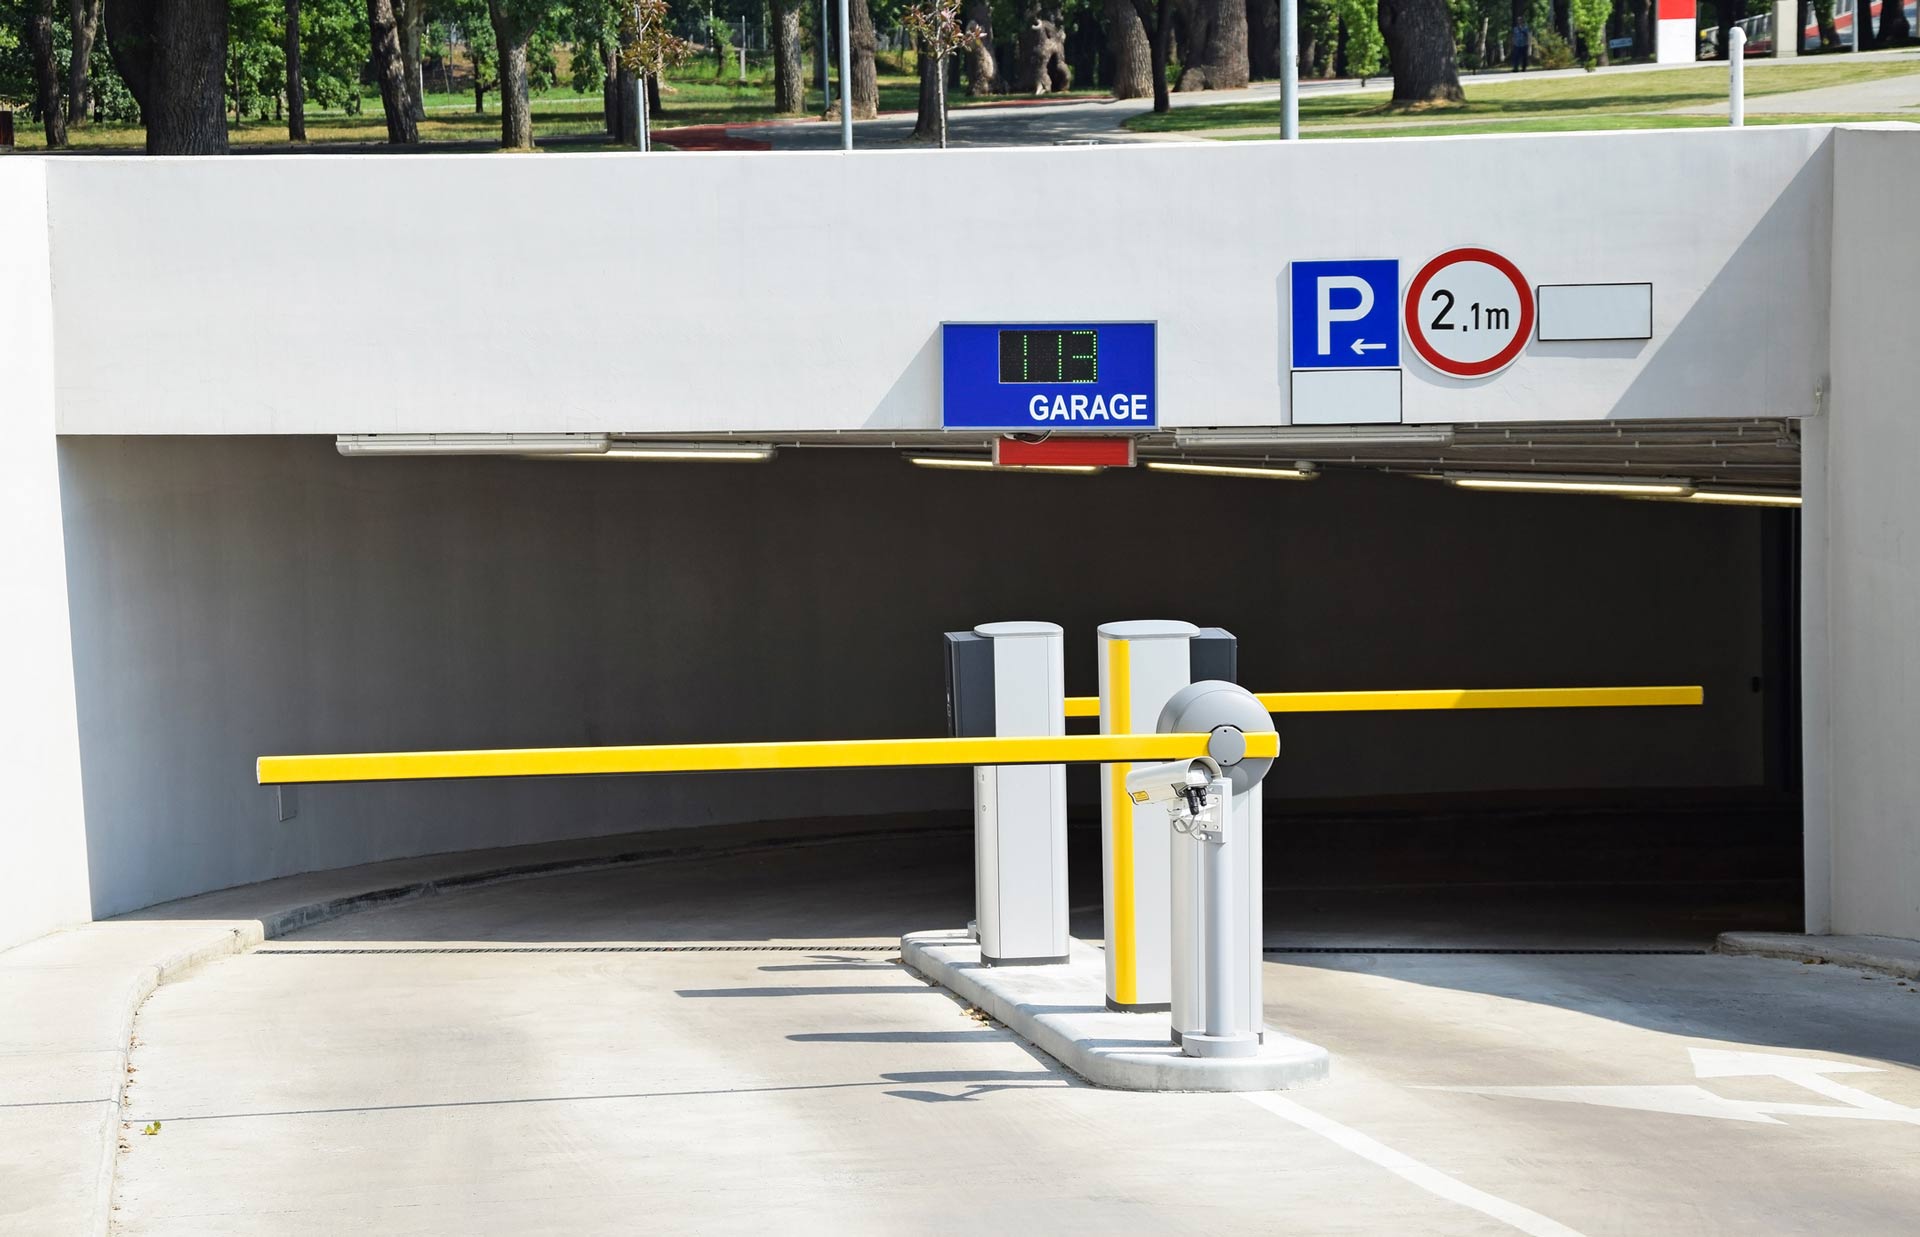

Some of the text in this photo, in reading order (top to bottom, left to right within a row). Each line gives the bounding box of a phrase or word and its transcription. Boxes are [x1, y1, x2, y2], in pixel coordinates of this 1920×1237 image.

[1317, 276, 1375, 355] P
[1431, 289, 1510, 332] 2.1m
[1023, 330, 1097, 383] 113
[1029, 394, 1148, 421] GARAGE
